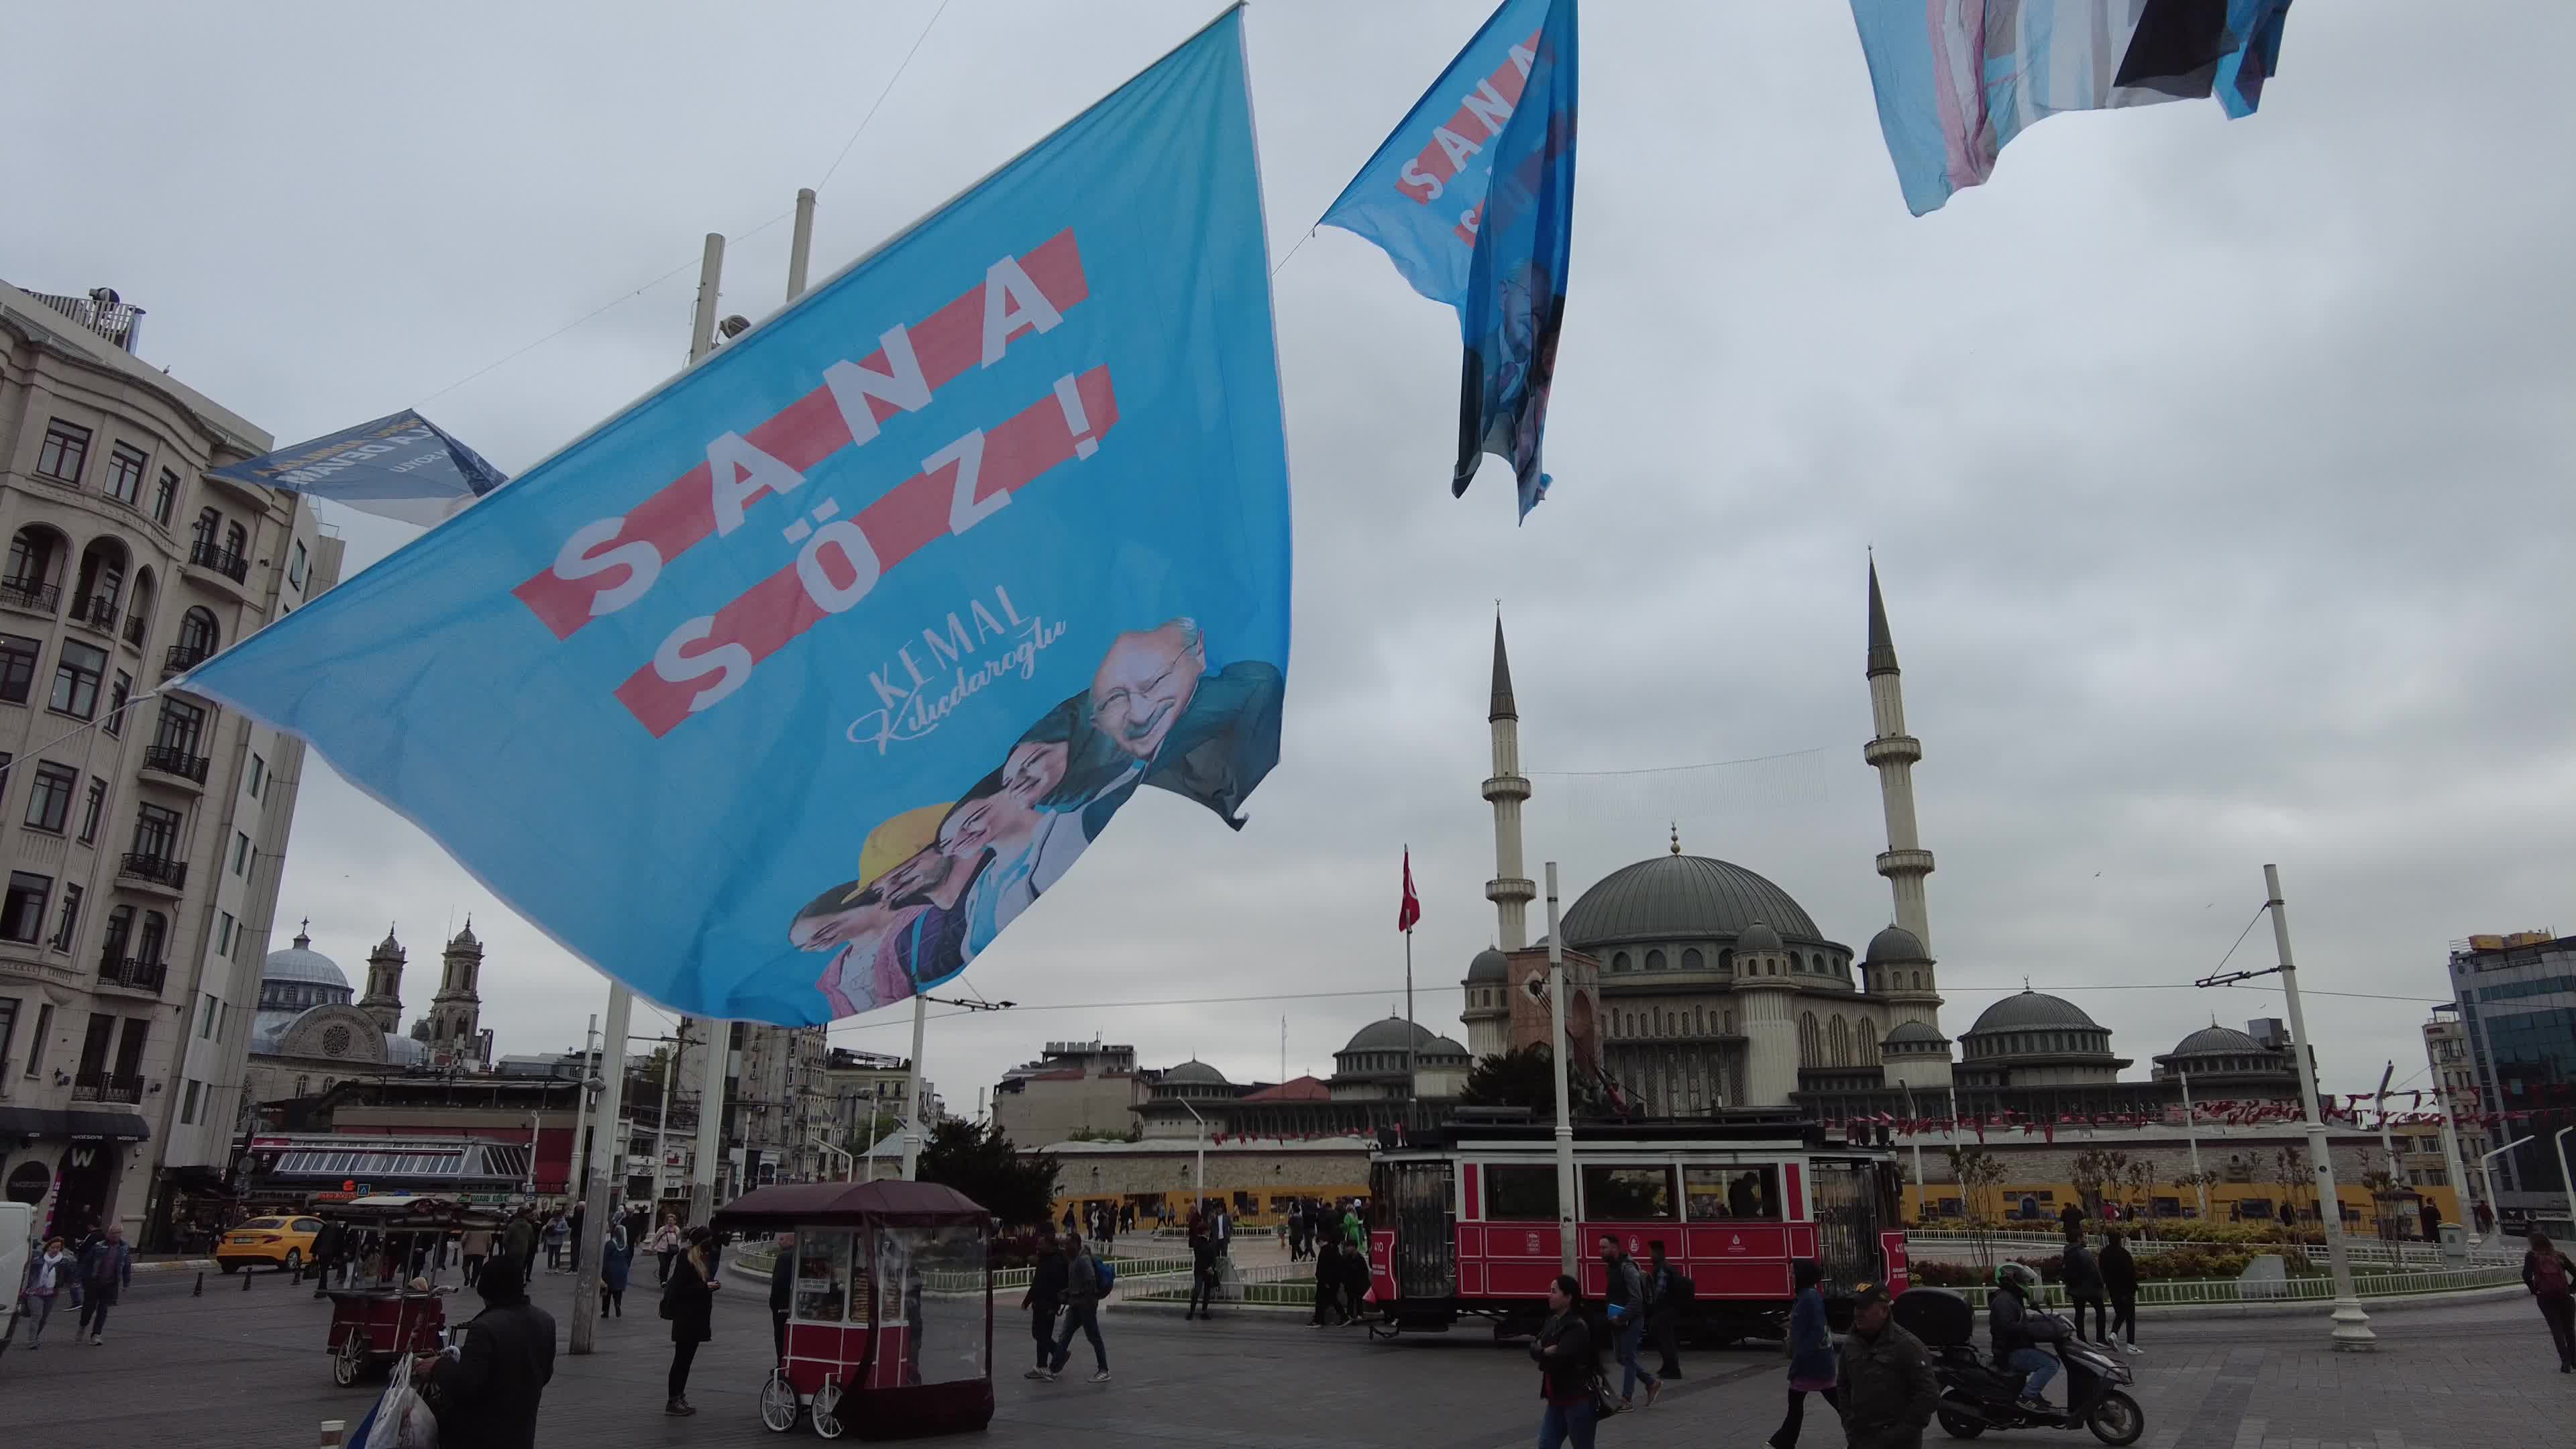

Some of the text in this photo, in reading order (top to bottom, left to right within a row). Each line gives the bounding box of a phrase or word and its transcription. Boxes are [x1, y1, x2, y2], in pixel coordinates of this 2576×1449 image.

[1400, 44, 1536, 200] SANA
[553, 254, 1063, 616] SANA
[653, 372, 1100, 712] SÖZ!
[869, 584, 1030, 710] KEMAL
[71, 1148, 96, 1167] W
[1375, 1242, 1383, 1252] 410
